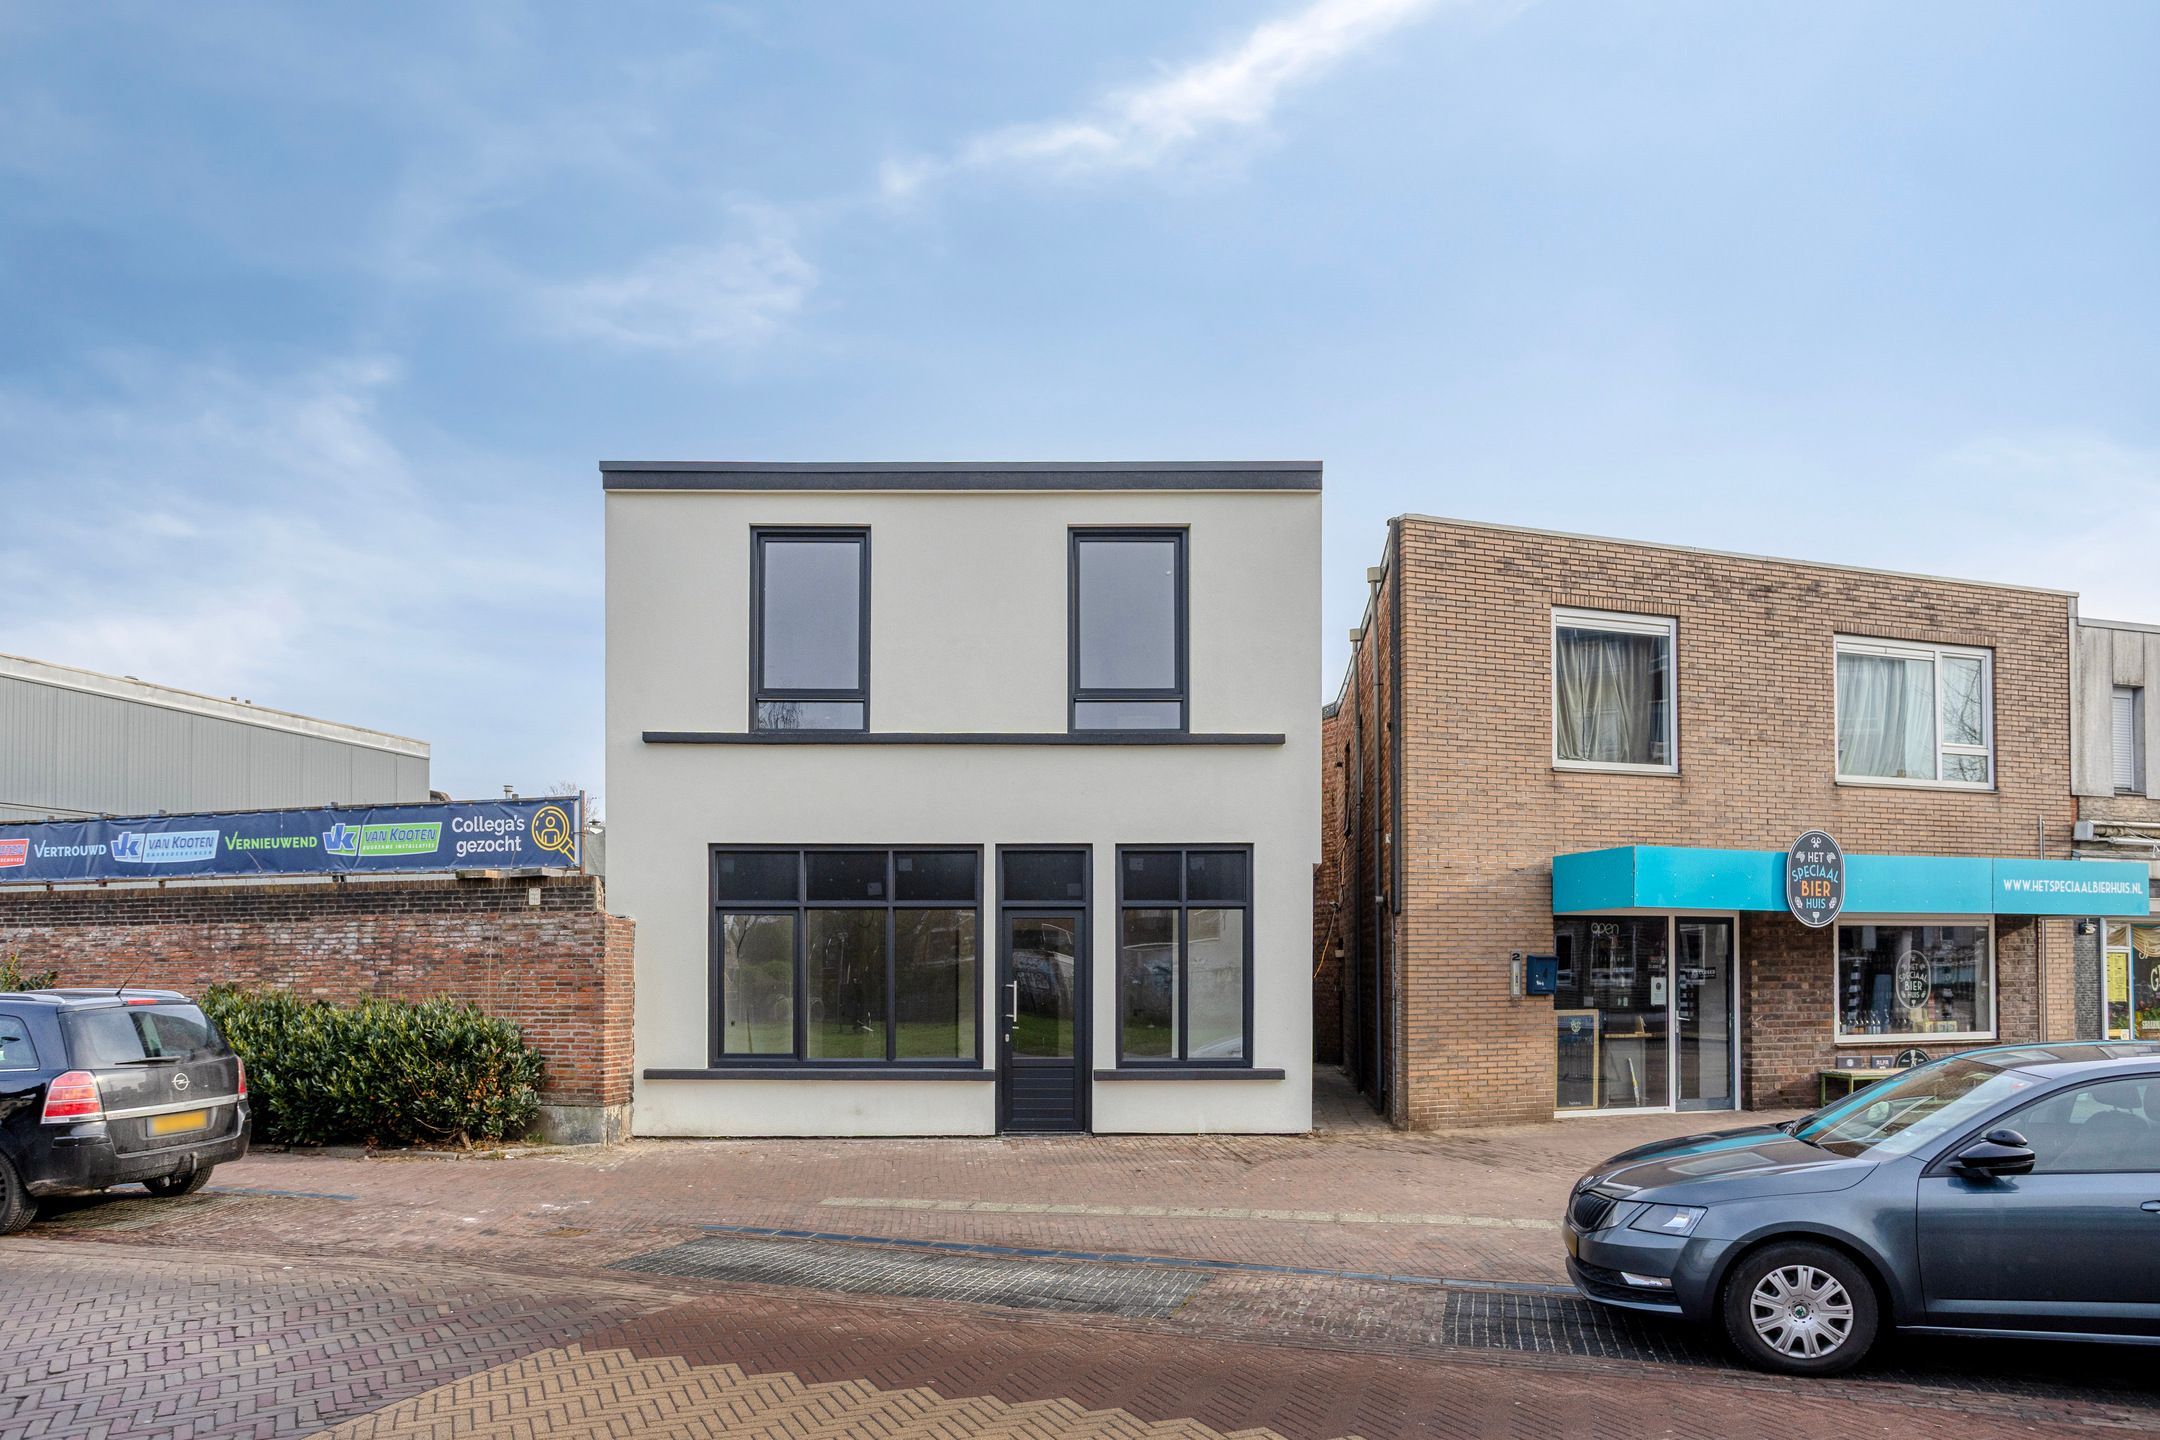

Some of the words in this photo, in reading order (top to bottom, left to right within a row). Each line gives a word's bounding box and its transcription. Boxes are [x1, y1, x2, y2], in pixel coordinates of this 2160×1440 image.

[452, 815, 525, 836] Collega's
[225, 831, 318, 850] VERNIEUWEND
[365, 830, 387, 842] VAN
[389, 828, 436, 841] KOOTEN
[34, 840, 107, 858] VERTROUWD
[148, 838, 170, 850] VAN
[171, 836, 214, 849] KOOTEN
[456, 835, 522, 857] gezocht
[1807, 851, 1824, 863] HET
[1792, 864, 1839, 883] SPECIAAL
[1801, 880, 1831, 897] BIER
[2003, 879, 2144, 895] WWW.HETSPECIAALBIERHUIS.NL
[1806, 898, 1826, 909] HUIS
[1591, 922, 1620, 936] open
[1511, 953, 1520, 961] 2
[1899, 970, 1928, 983] SPECIAAL
[1904, 980, 1923, 991] BIER
